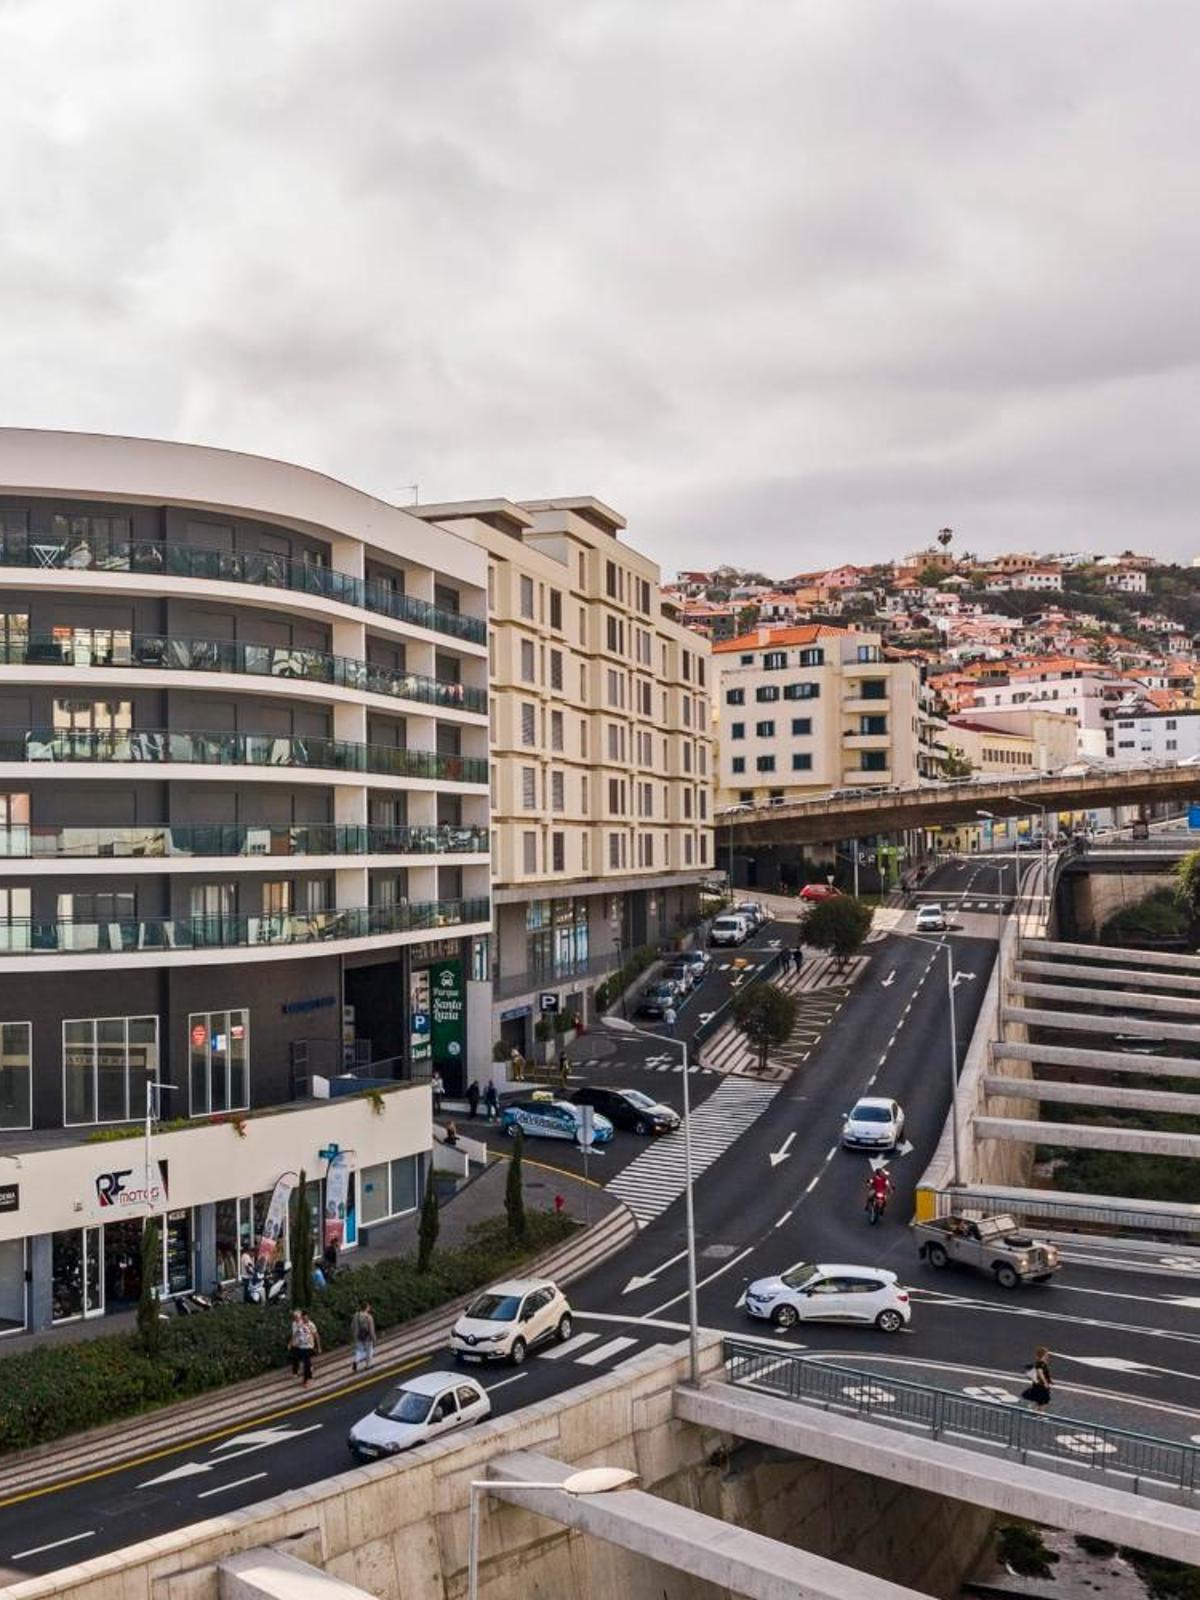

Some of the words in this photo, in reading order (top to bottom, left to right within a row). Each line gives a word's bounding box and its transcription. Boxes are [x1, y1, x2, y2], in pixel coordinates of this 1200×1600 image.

[432, 998, 462, 1011] Santa
[542, 996, 556, 1009] P
[415, 1015, 426, 1030] P
[96, 1169, 133, 1207] RF
